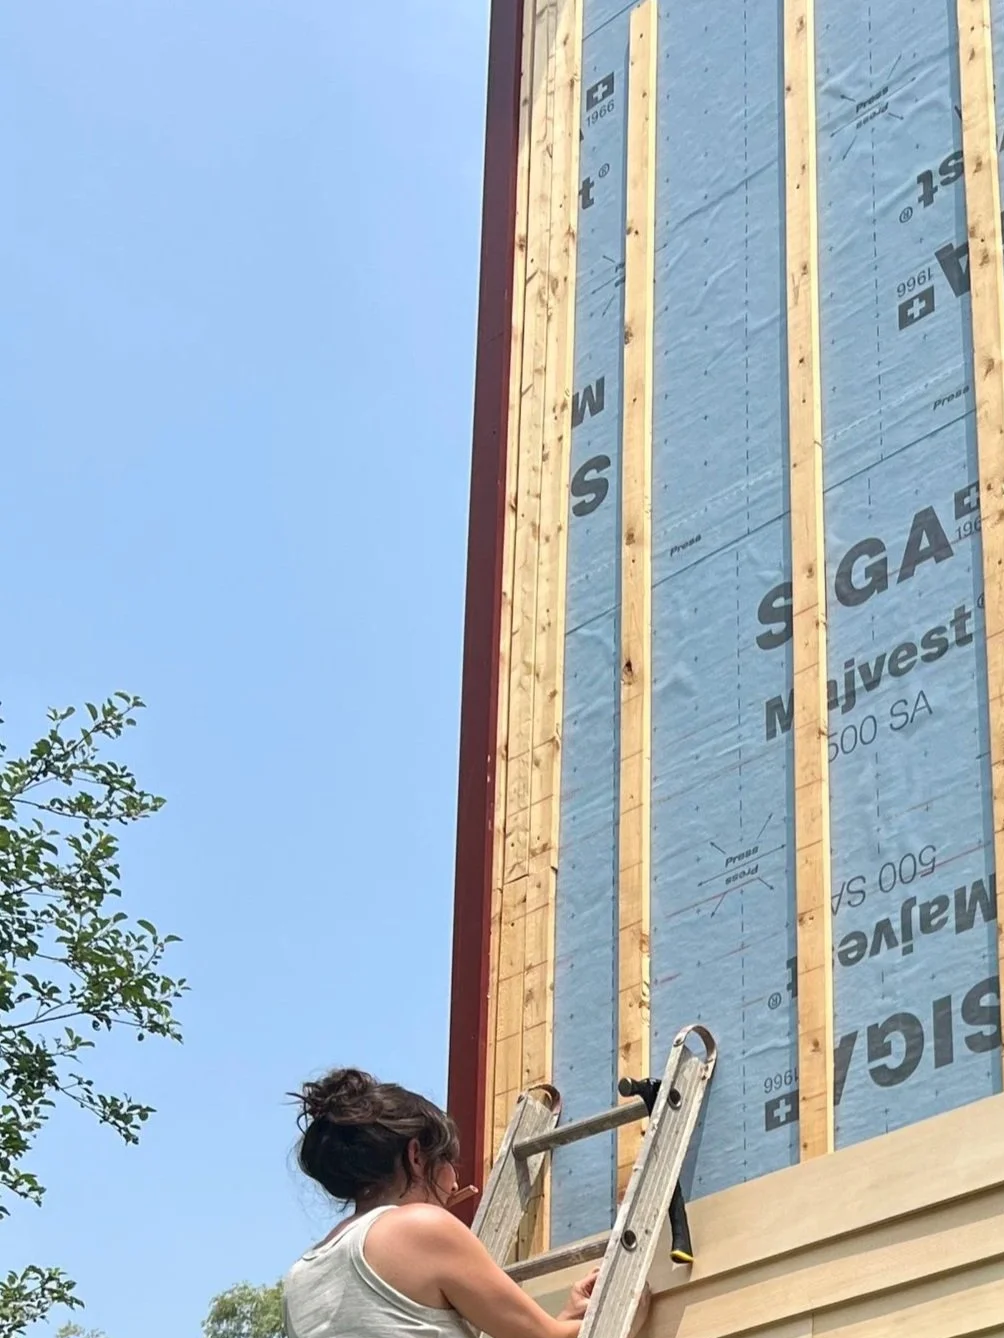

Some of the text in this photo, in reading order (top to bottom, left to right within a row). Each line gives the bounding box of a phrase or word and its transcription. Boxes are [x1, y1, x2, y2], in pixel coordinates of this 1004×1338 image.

[586, 100, 615, 128] 1966
[856, 86, 889, 113] Press
[896, 267, 934, 297] 1966
[933, 384, 969, 411] Press
[756, 505, 954, 651] SGA
[889, 689, 933, 732] SA
[725, 845, 760, 867] Press
[879, 844, 937, 893] 500
